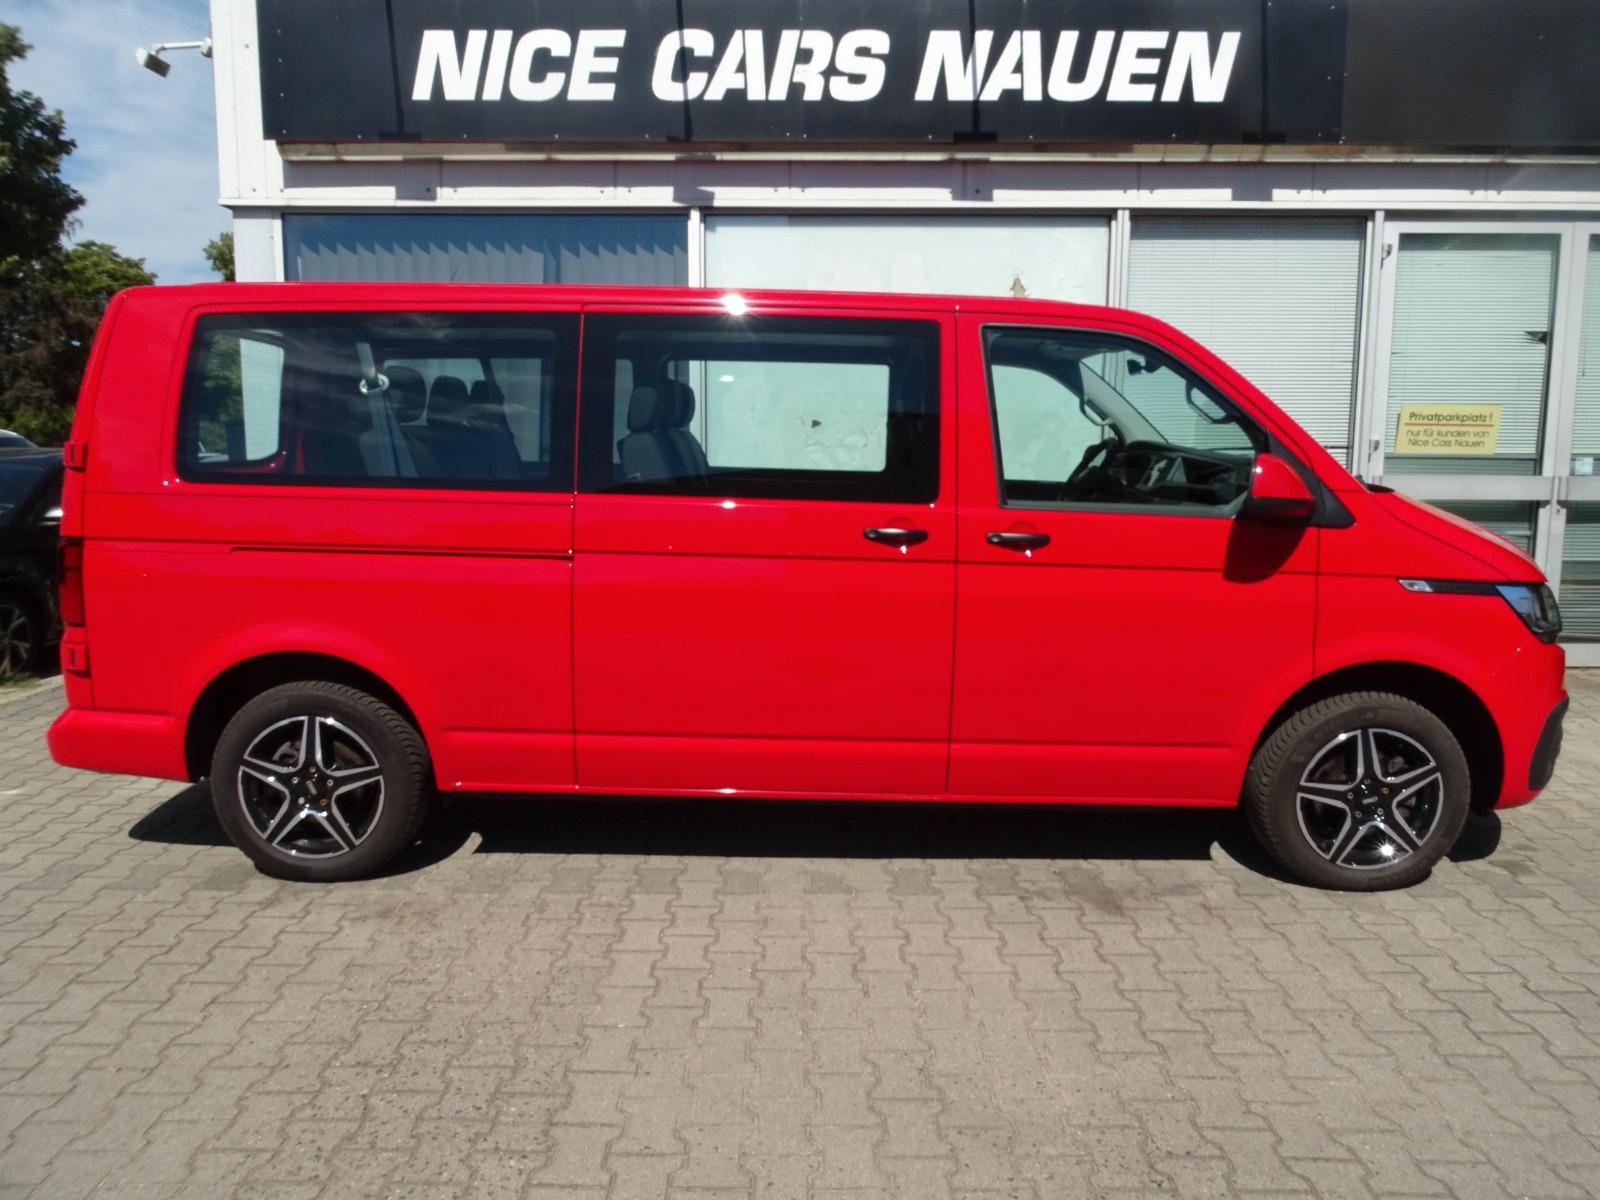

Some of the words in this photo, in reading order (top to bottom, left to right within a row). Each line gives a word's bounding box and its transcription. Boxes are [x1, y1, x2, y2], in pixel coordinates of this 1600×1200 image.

[411, 29, 627, 101] NICE
[651, 29, 891, 101] CARS
[914, 30, 1242, 102] NAUEN
[1406, 429, 1421, 437] nur
[1423, 428, 1434, 437] für
[1436, 428, 1471, 438] kunden
[1473, 430, 1490, 438] von
[1407, 438, 1429, 447] Nice
[1454, 439, 1485, 448] Nauen
